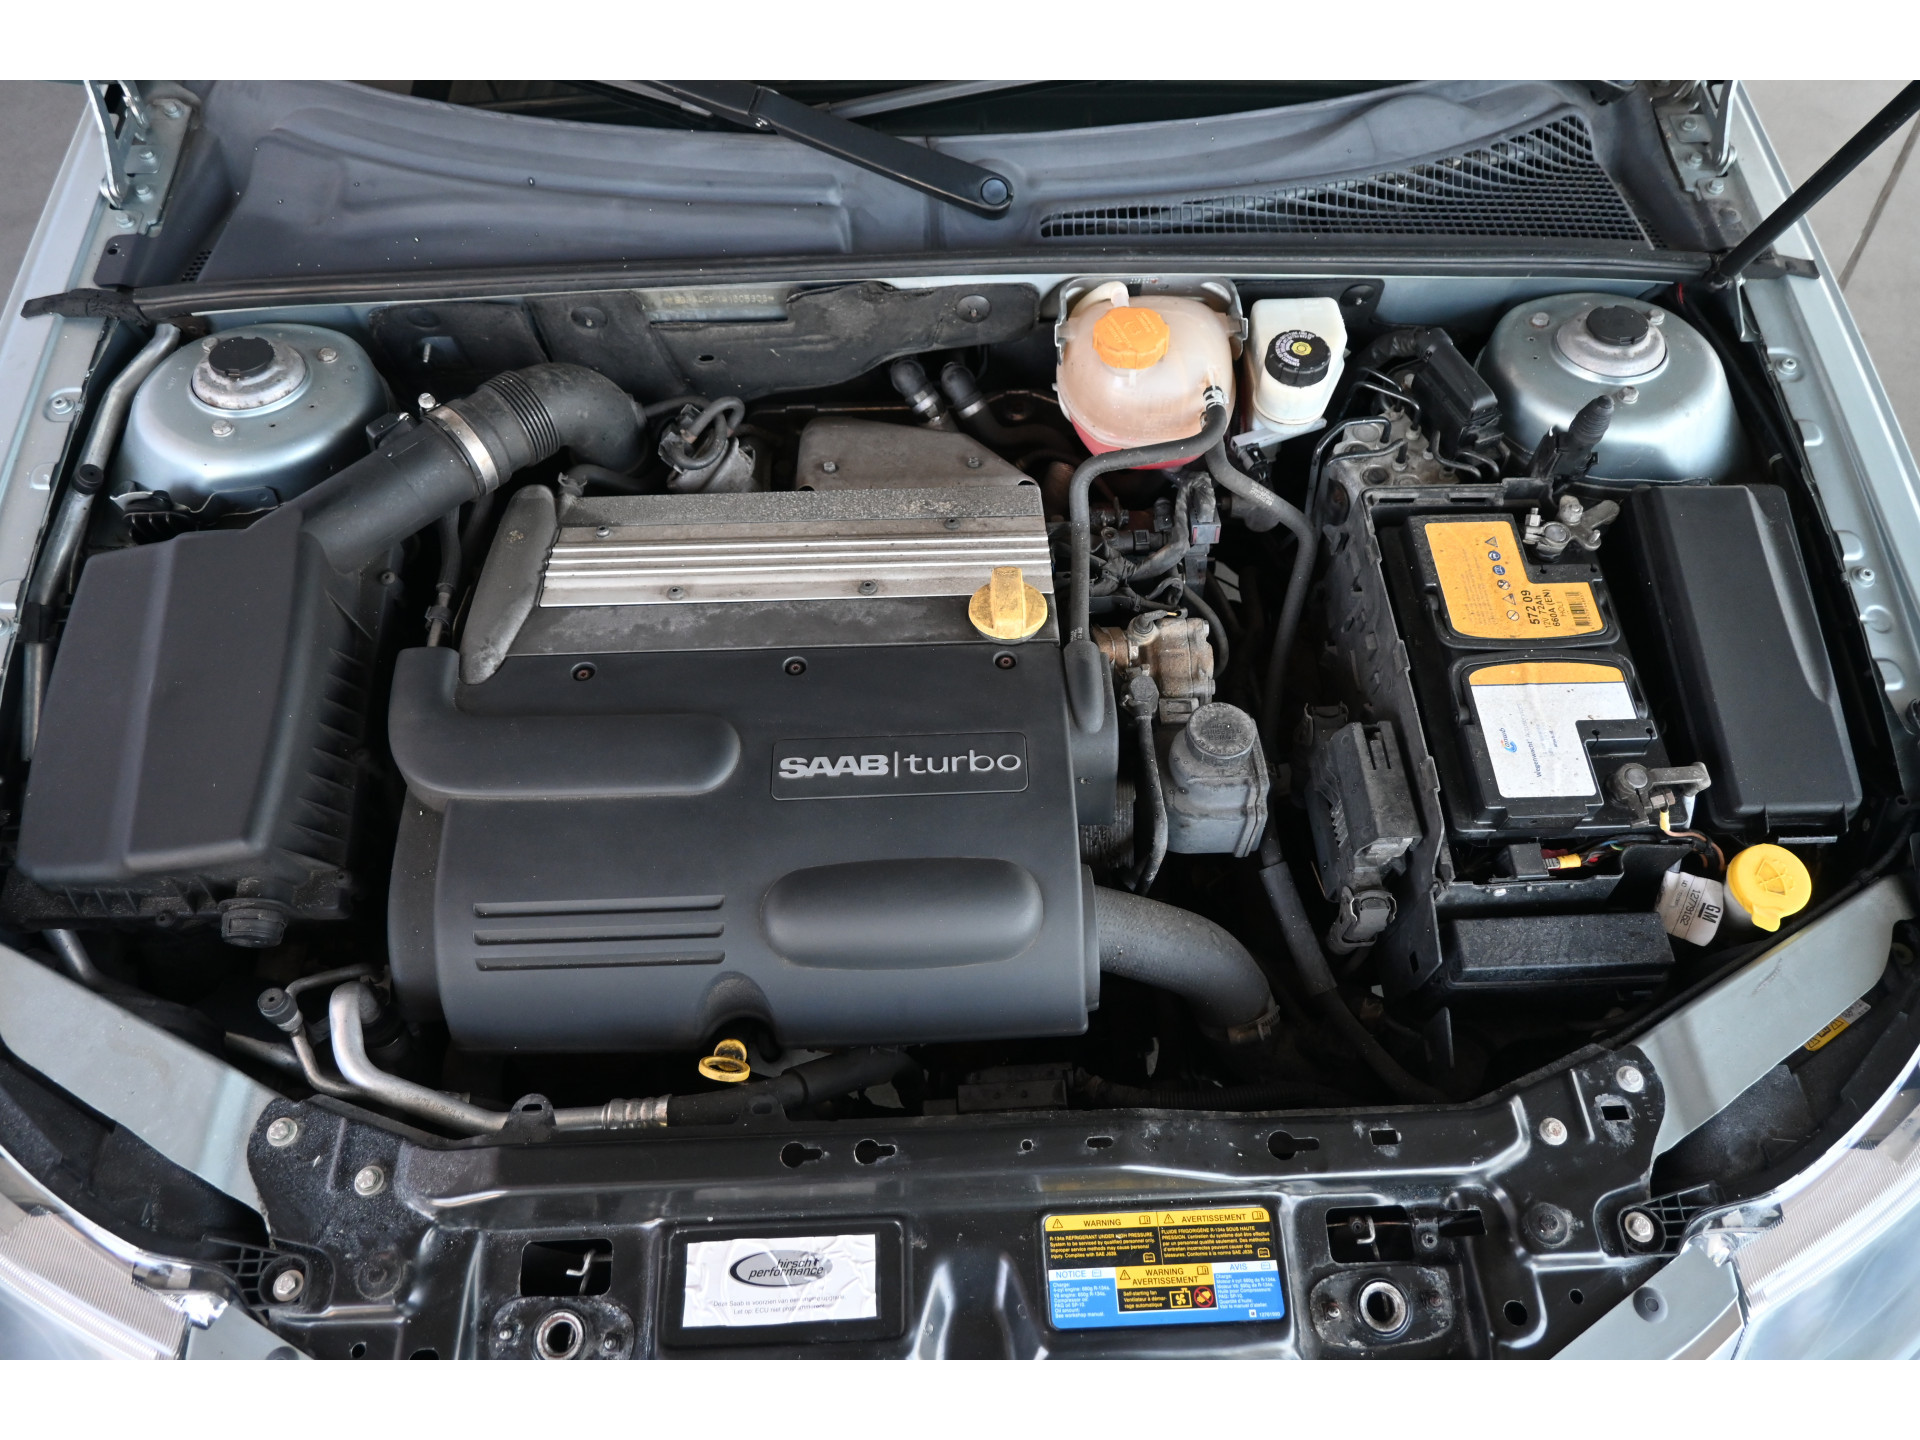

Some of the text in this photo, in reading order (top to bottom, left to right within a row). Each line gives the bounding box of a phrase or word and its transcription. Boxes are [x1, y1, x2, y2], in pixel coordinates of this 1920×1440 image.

[1520, 589, 1540, 625] 572 09
[1534, 595, 1552, 629] 12V 72Ah
[1542, 588, 1561, 628] 660A (EN)
[778, 750, 1022, 779] SAAB turbo
[1680, 889, 1701, 926] 12779162
[1702, 904, 1721, 924] GM
[1083, 1218, 1122, 1227] WARNING
[1181, 1213, 1247, 1223] AVERTISSEMENT
[777, 1257, 812, 1269] hirsch
[1229, 1263, 1248, 1271] AVIS
[748, 1266, 824, 1280] performance
[1055, 1269, 1087, 1279] NOTICE
[1145, 1267, 1184, 1277] WARNING
[1132, 1275, 1199, 1286] AVERTISSEMENT
[729, 1299, 745, 1307] Saab
[752, 1298, 776, 1306] voorzien
